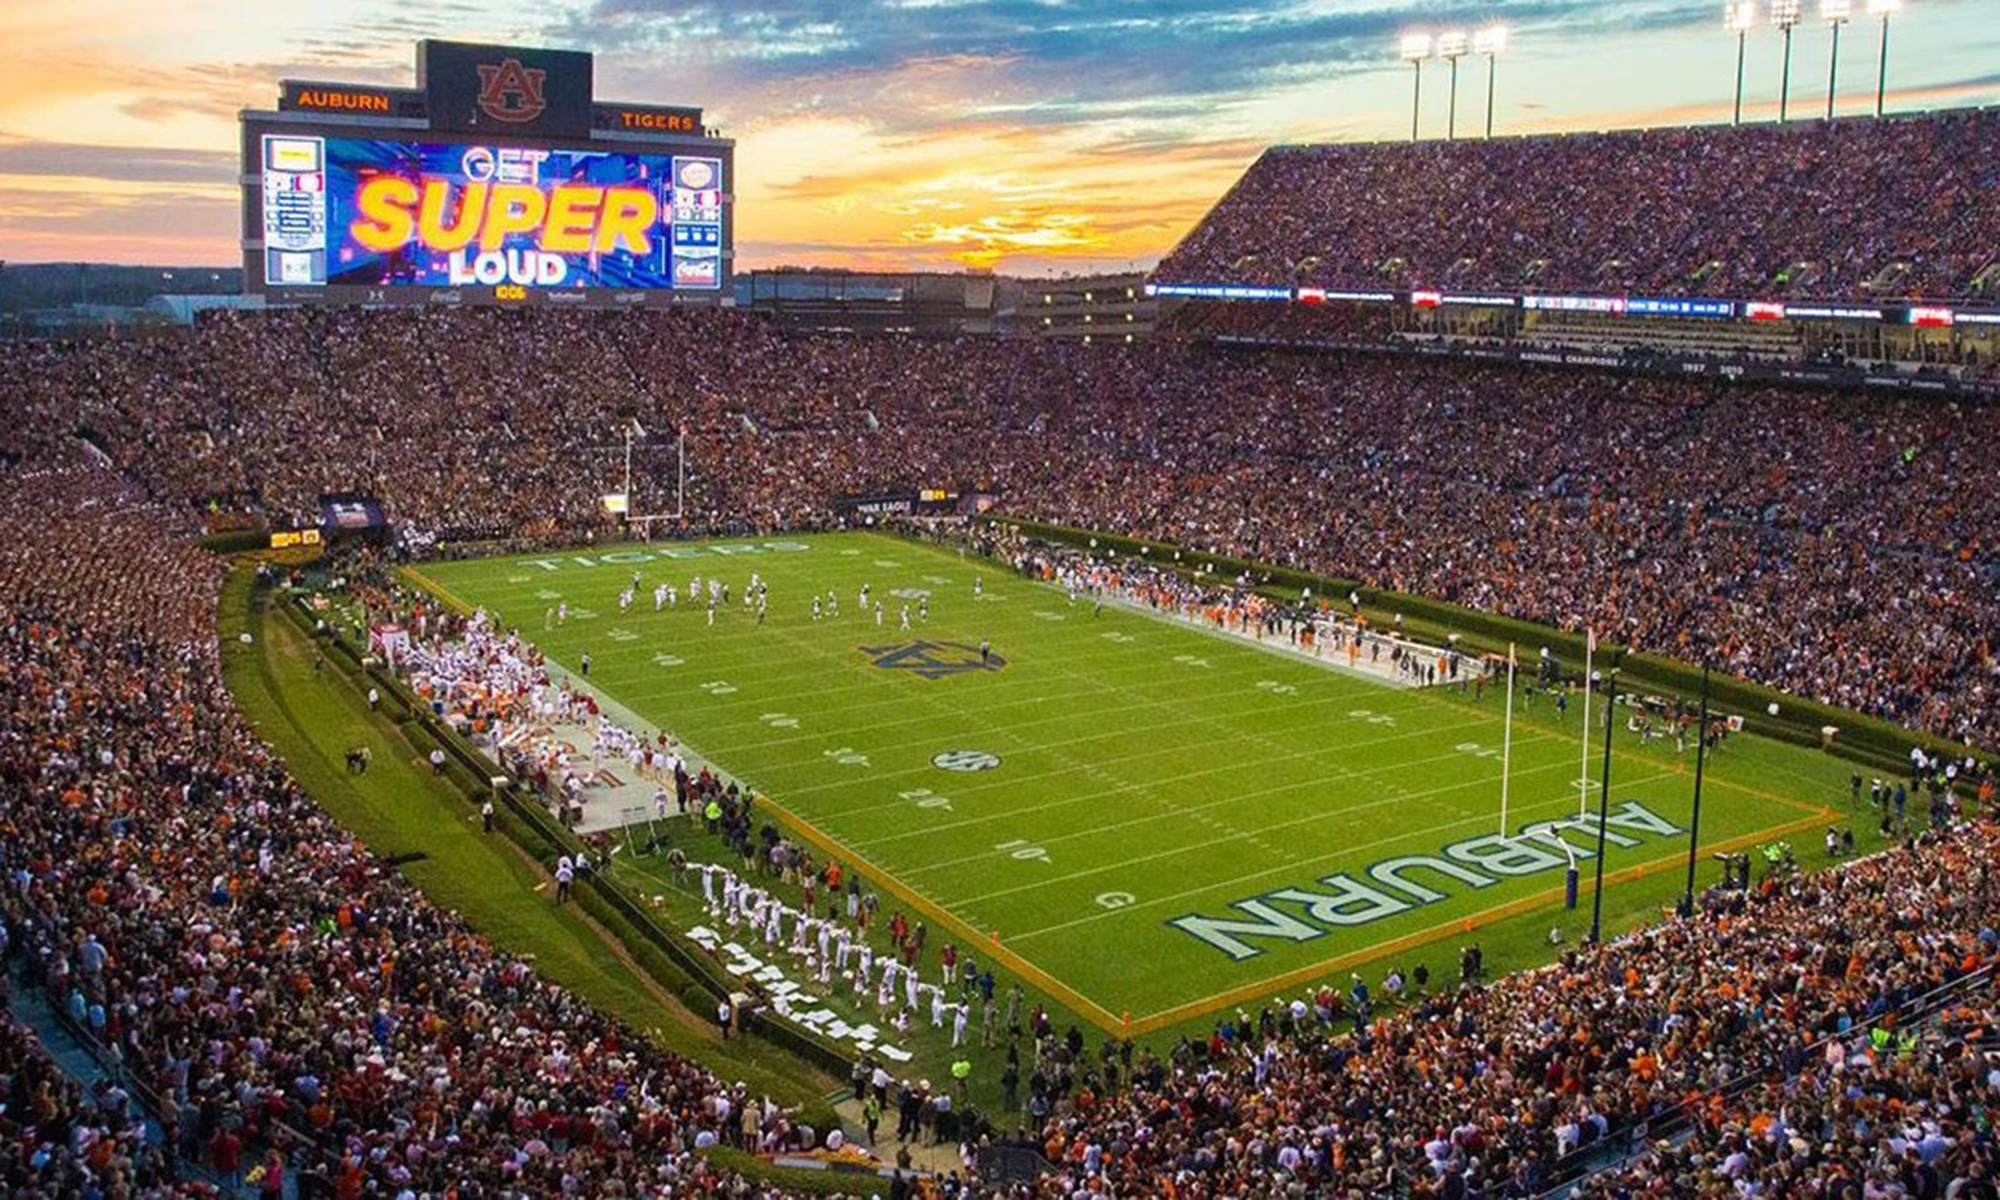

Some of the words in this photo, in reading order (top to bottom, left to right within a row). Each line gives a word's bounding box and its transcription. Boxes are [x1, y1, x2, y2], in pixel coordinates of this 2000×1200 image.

[299, 90, 389, 111] AUBURN
[621, 112, 694, 130] TIGERS
[462, 147, 549, 185] GET
[350, 176, 657, 253] SUPER
[449, 249, 568, 285] LOUD
[1519, 351, 1563, 364] NATIONAL
[1565, 354, 1619, 367] CHAMPIONS
[857, 502, 880, 514] WAR
[882, 500, 911, 512] EAGLE
[1166, 800, 1692, 963] AUBURN
